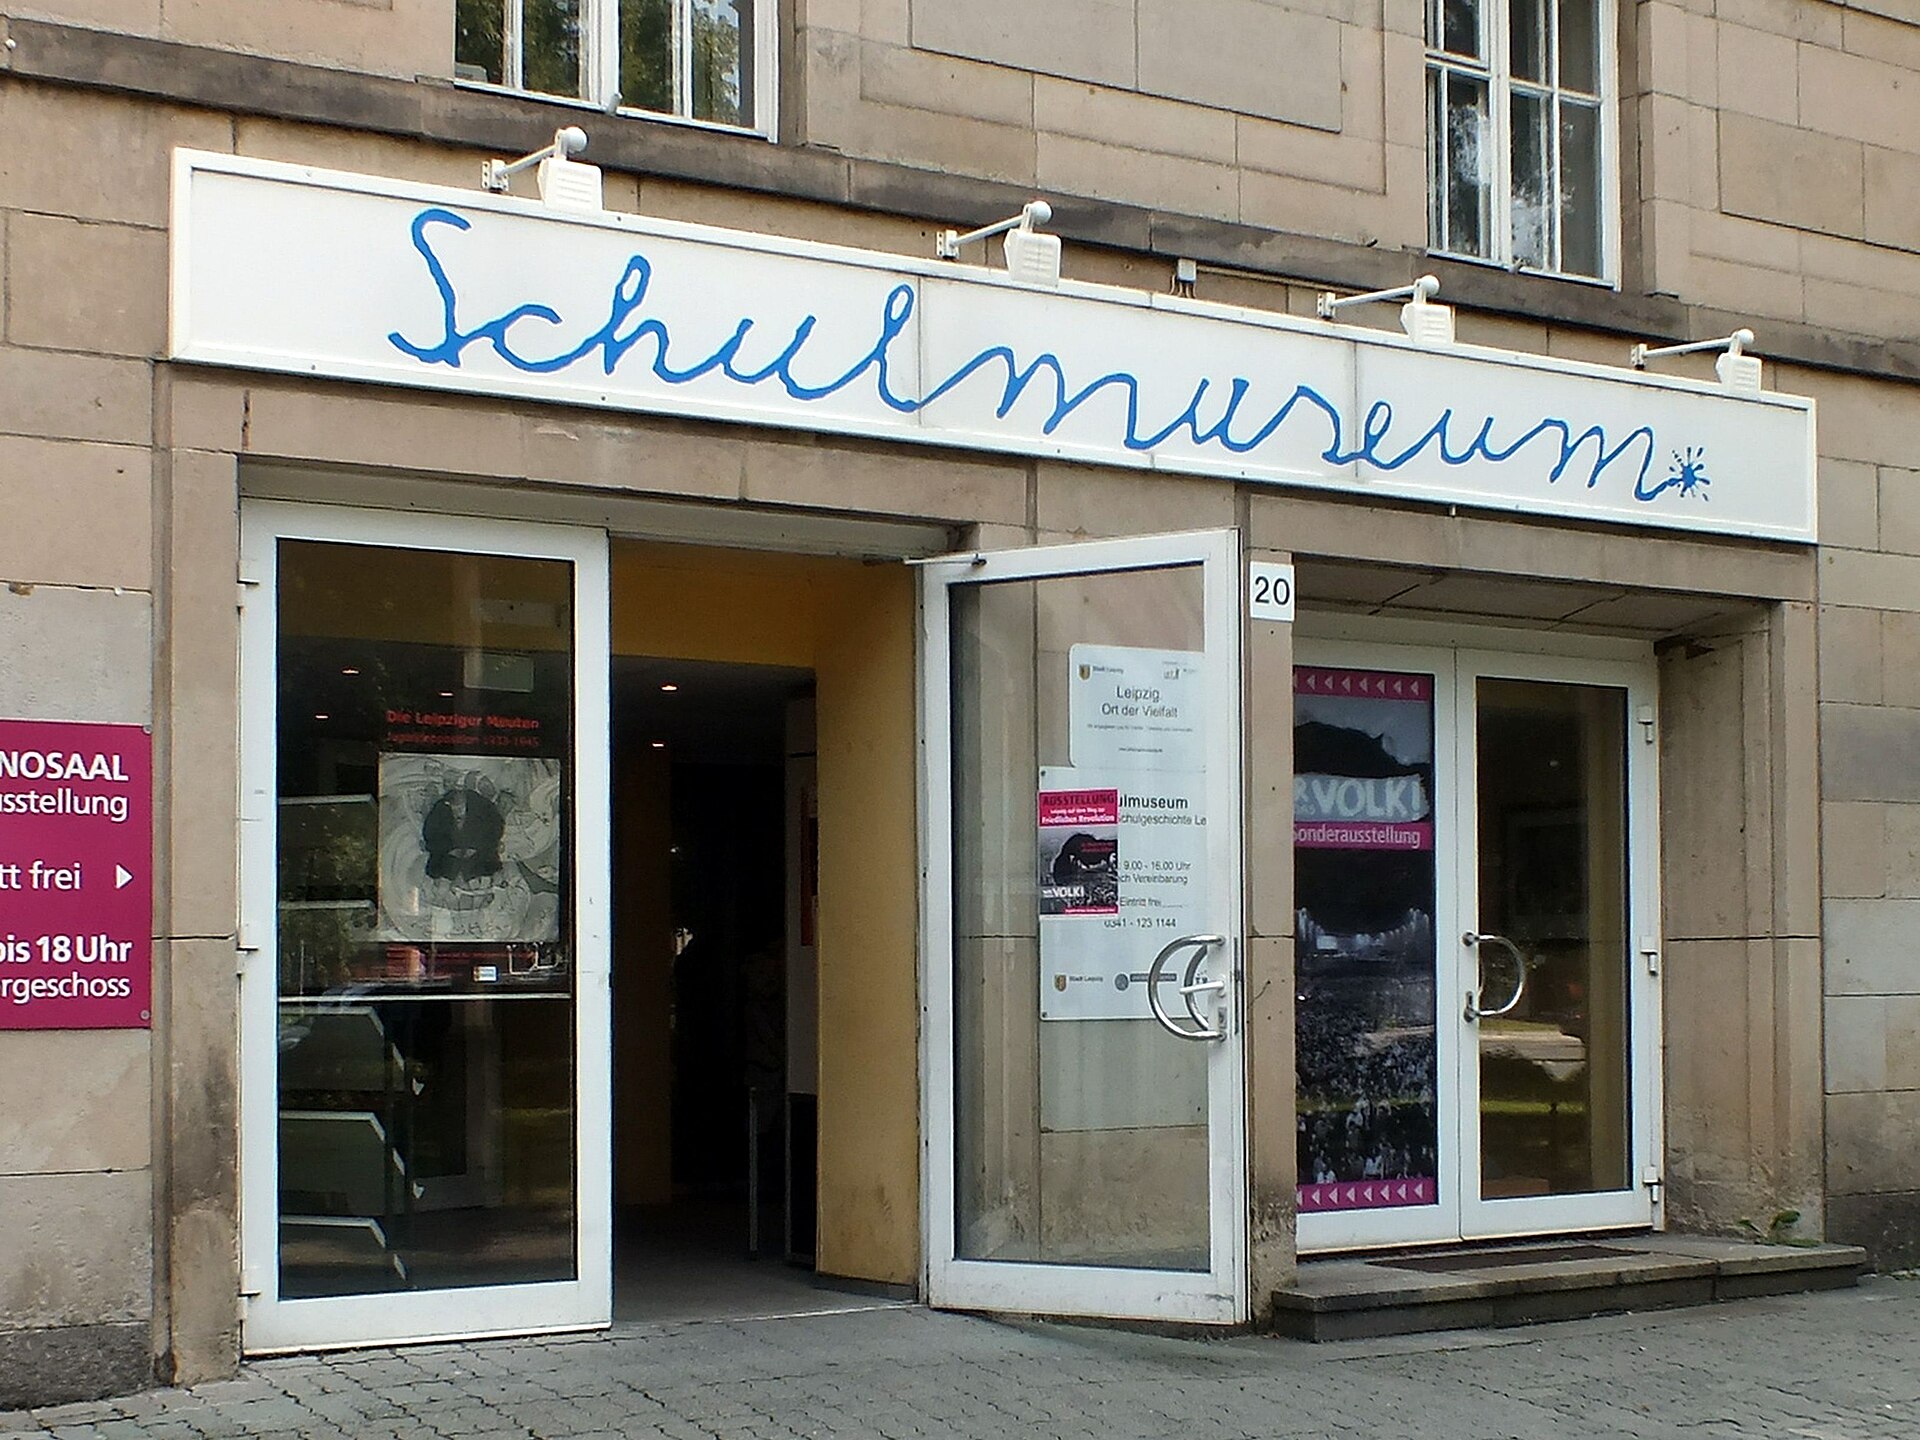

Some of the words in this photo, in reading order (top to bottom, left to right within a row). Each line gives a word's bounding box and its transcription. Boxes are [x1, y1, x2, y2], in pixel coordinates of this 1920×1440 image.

[387, 208, 1680, 501] Schulmuseum
[1254, 576, 1291, 605] 20
[1116, 685, 1160, 703] Leipzig
[386, 710, 411, 724] Die
[415, 712, 482, 728] Leipziger
[1102, 703, 1119, 715] Ort
[1121, 704, 1139, 716] der
[1142, 705, 1178, 718] Vielfalt
[0, 750, 129, 781] NOSAAL
[1042, 794, 1114, 806] AUSSTELLUNG
[1312, 778, 1421, 818] VOLK!
[1119, 813, 1192, 826] chulgeschichte
[1293, 823, 1421, 848] onderausstellung
[1123, 860, 1142, 870] 9.00
[28, 860, 80, 890] frei
[1132, 873, 1188, 886] Vereinbarung
[1137, 918, 1153, 928] 123
[1156, 918, 1176, 928] 1144
[36, 935, 71, 962] 18
[77, 935, 132, 963] Uhr
